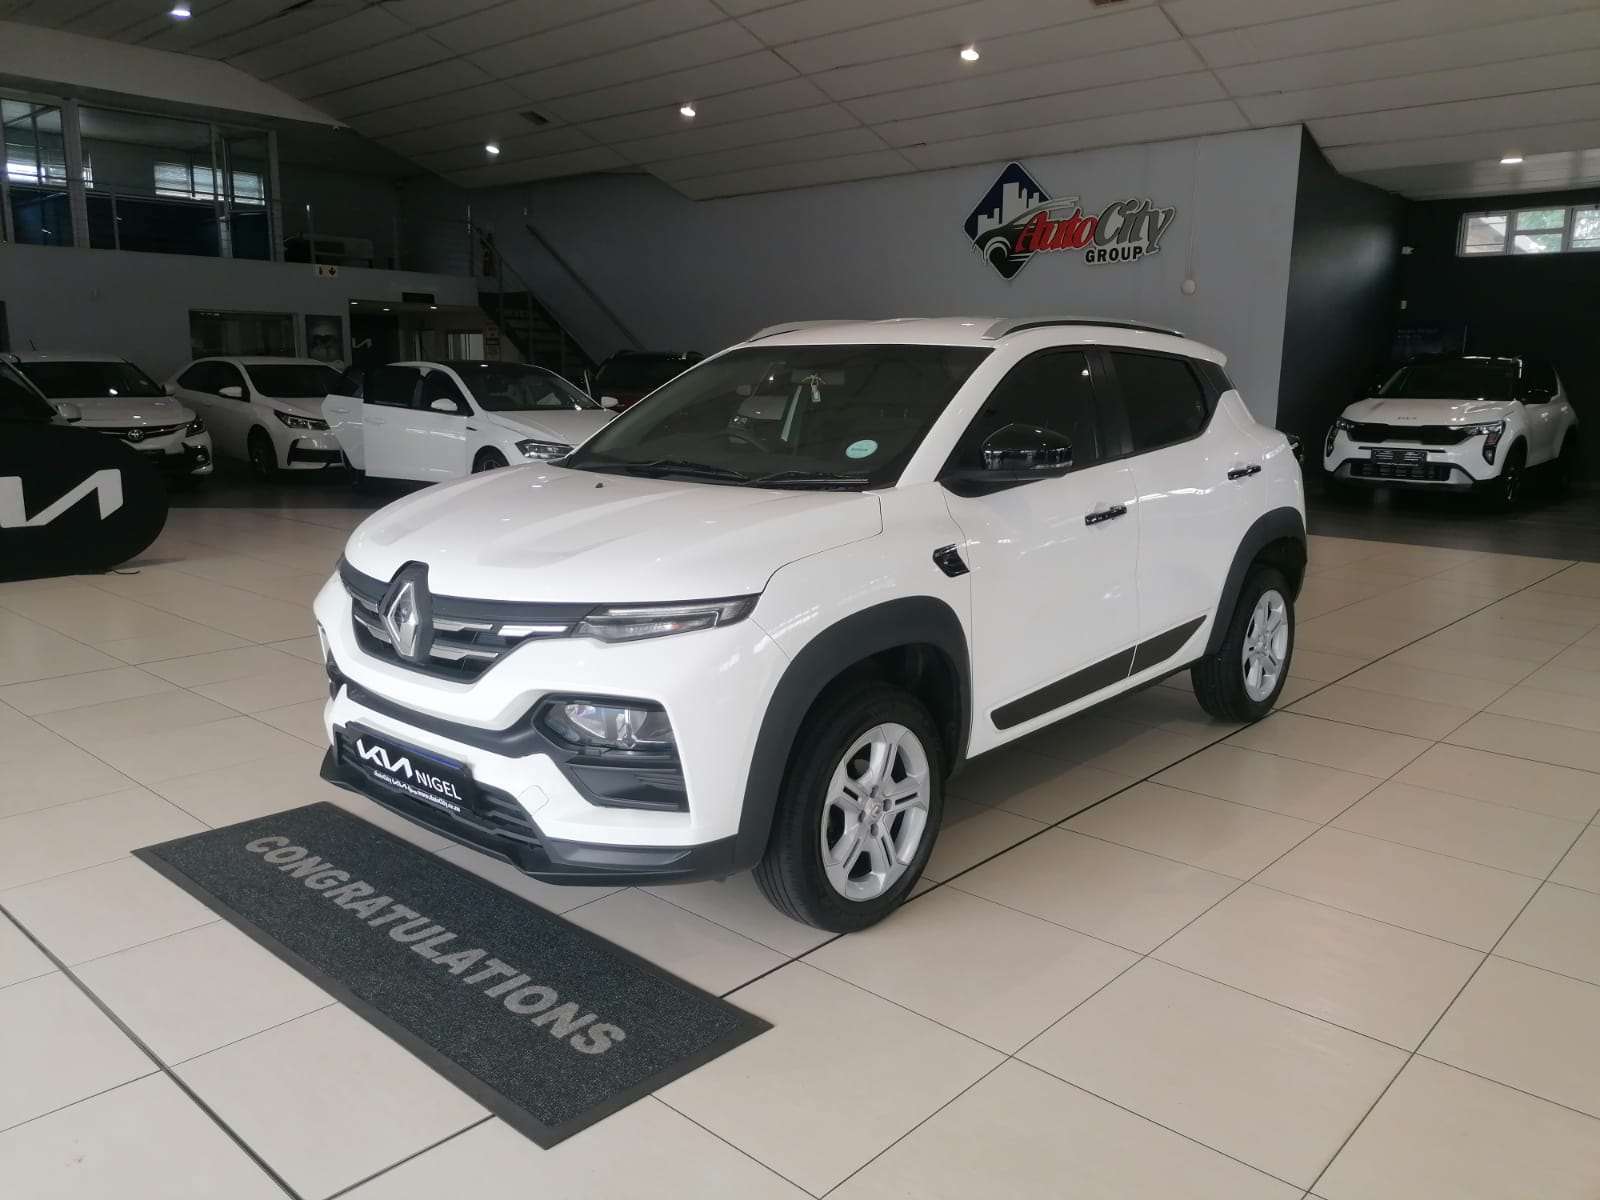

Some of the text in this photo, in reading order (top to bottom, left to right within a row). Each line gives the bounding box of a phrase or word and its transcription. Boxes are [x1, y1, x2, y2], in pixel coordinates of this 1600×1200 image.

[1085, 247, 1143, 263] GROUP
[414, 769, 462, 800] NIGEL
[245, 835, 626, 1054] CONGRATULATIONS
